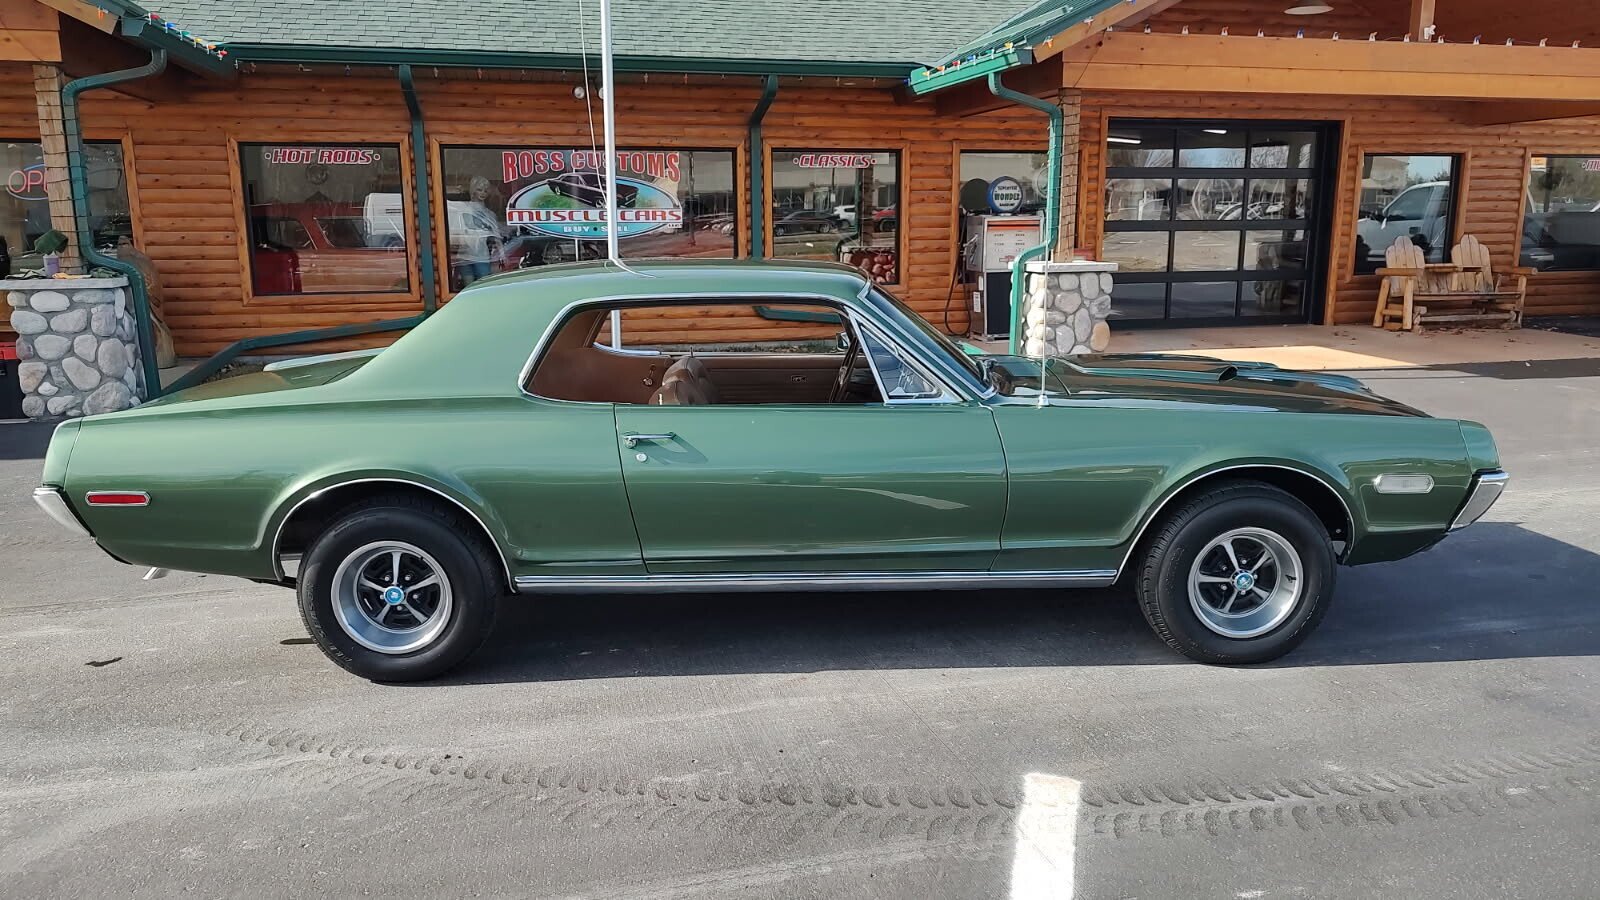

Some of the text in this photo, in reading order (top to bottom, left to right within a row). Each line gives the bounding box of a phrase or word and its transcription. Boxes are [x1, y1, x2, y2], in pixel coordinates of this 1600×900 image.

[272, 148, 373, 164] HOT RODS
[799, 154, 871, 168] CLASSICS
[502, 151, 681, 183] ROSS CUTOMS
[8, 170, 48, 193] OP
[507, 210, 682, 221] MUSCLE CARS
